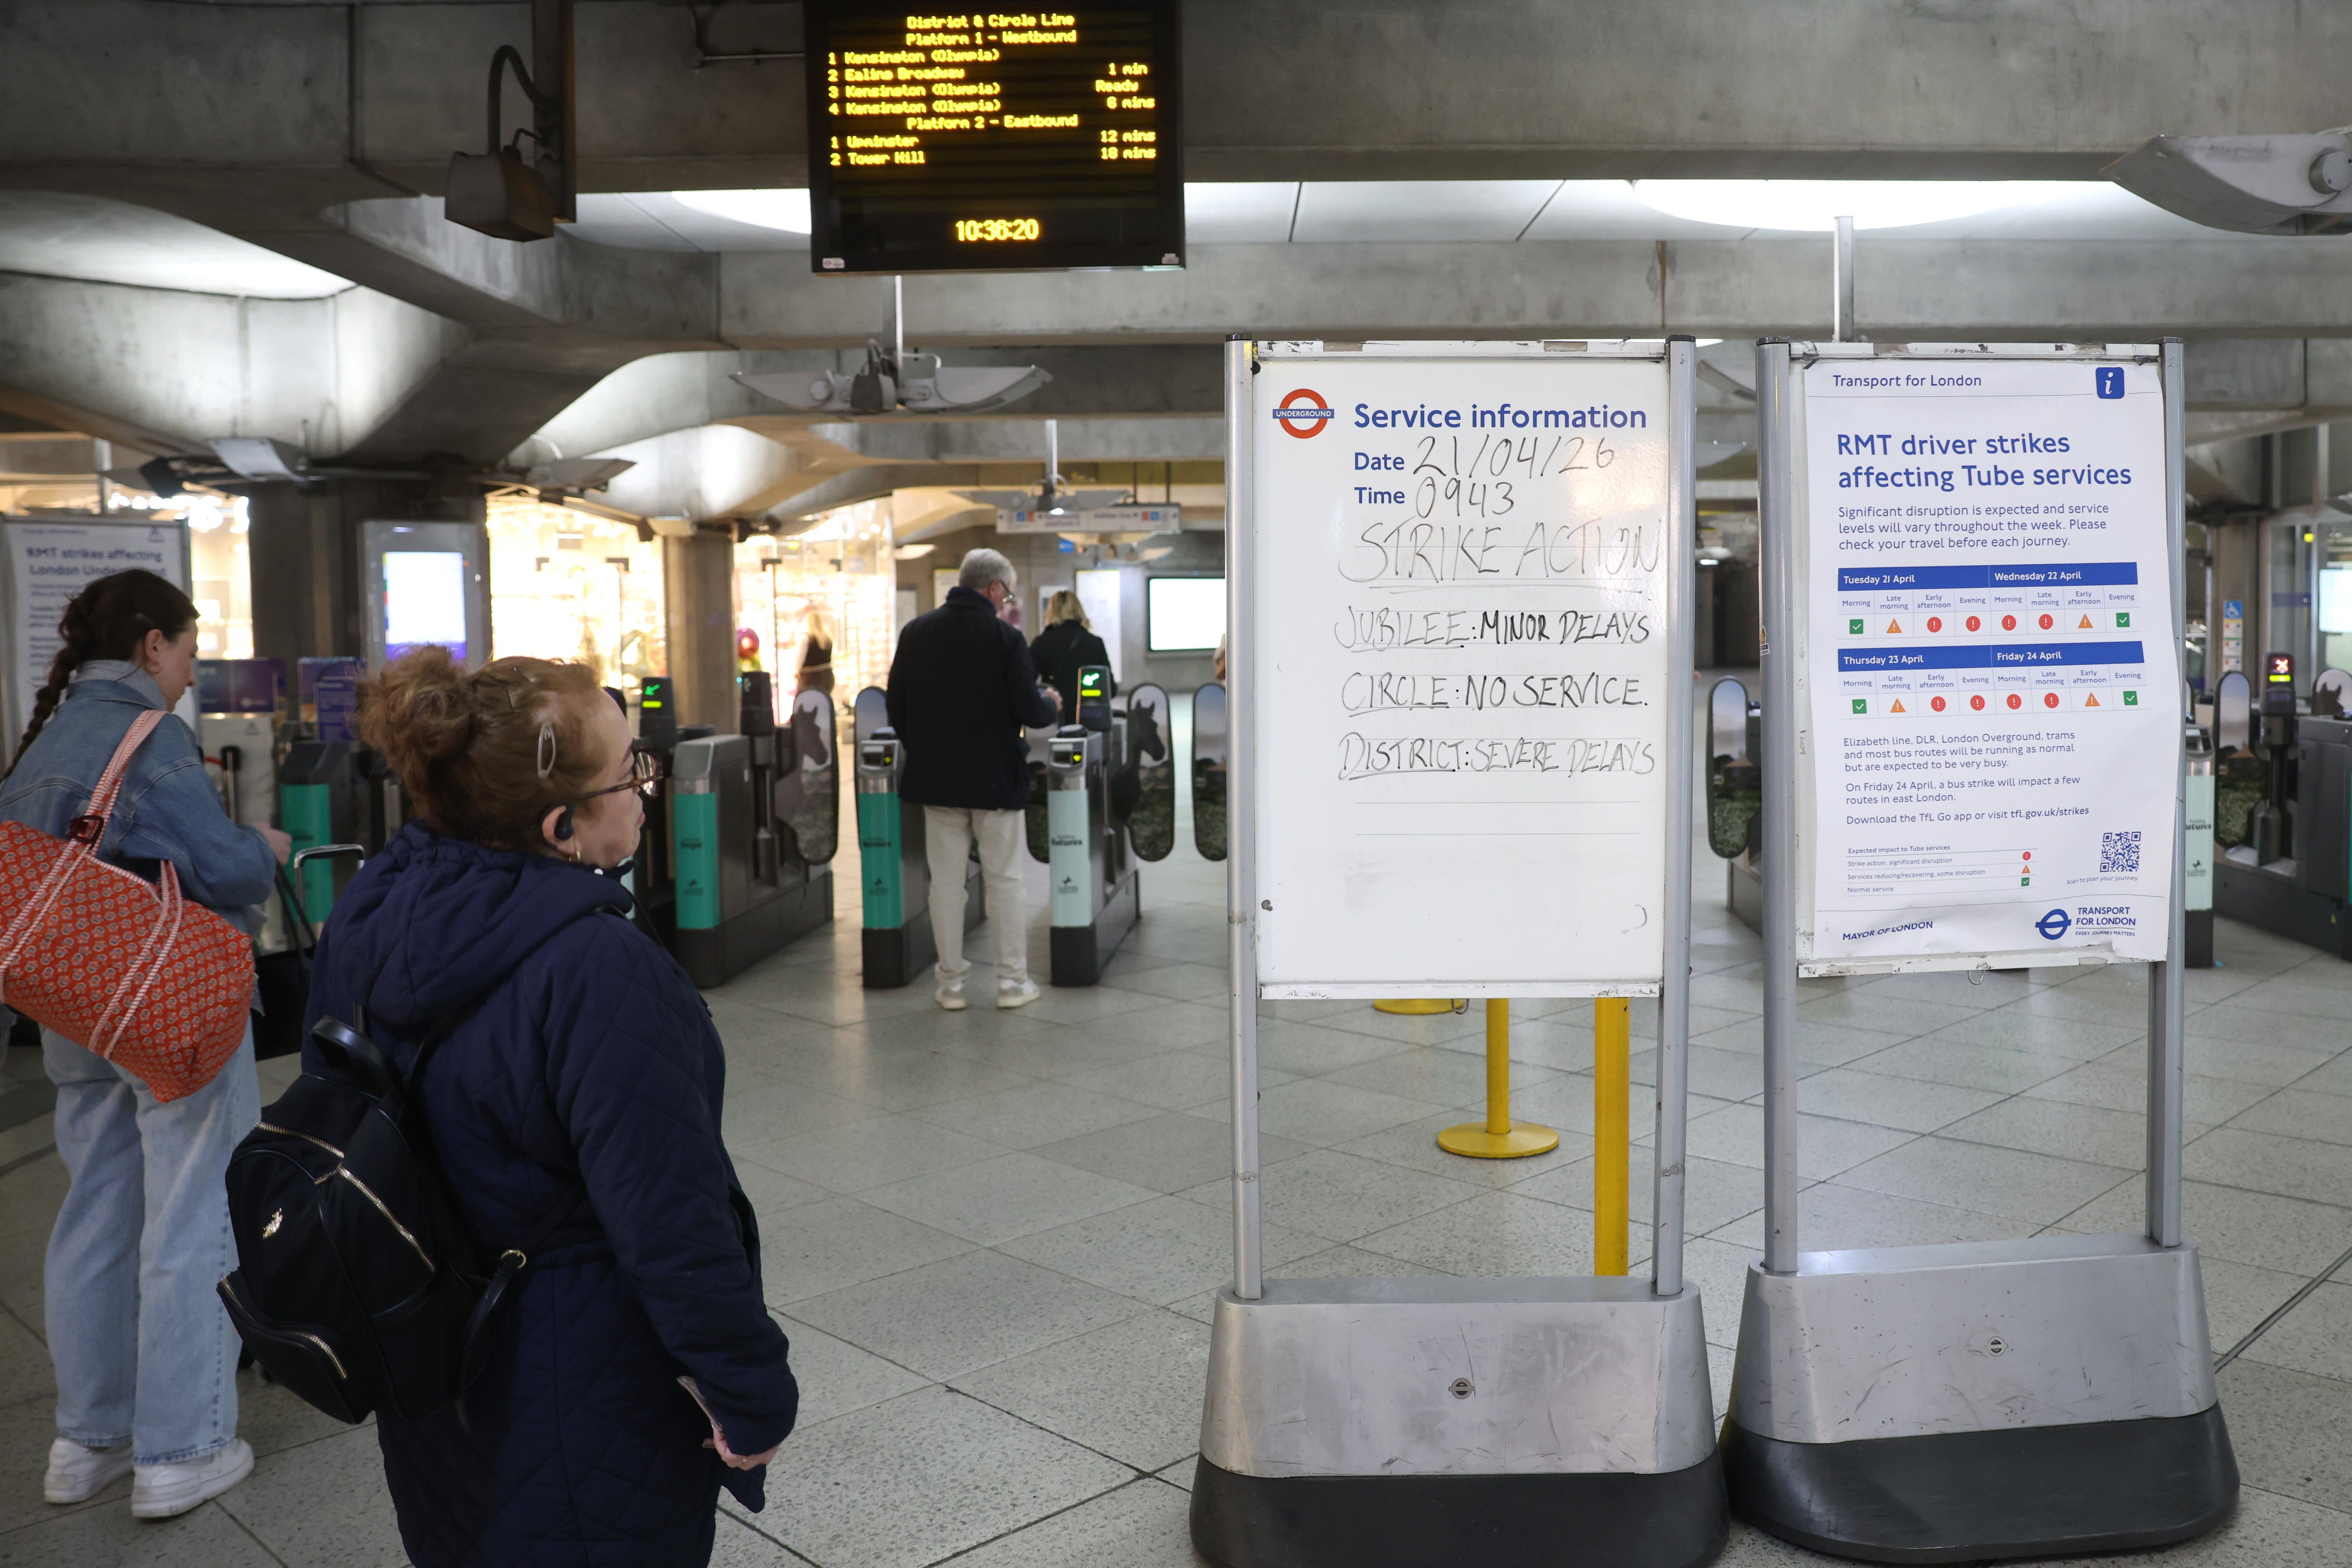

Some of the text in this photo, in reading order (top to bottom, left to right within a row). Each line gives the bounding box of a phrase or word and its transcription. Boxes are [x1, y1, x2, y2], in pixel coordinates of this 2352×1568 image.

[907, 13, 1075, 29] District & Circle Line
[906, 30, 1076, 46] Platform 1 Westbound
[829, 49, 999, 65] 1 Kensington (Olympia)
[828, 67, 965, 82] 2 Ealing Broadway
[1109, 63, 1147, 75] 1 min
[829, 82, 1000, 99] 3 Kensington (Olympia)
[1096, 79, 1138, 93] Ready
[829, 99, 1001, 115] 4 Kensington (Olympia)
[1107, 96, 1155, 109] 6 mins
[907, 114, 1078, 130] Platform 2 Eastbound
[831, 135, 919, 149] 1 Upminster
[1101, 130, 1156, 143] 12 mins
[831, 151, 925, 166] 2 Tower Hill
[1101, 147, 1156, 159] 18 mins
[956, 219, 1040, 241] 10:36:20
[1833, 375, 1981, 389] Transport for London
[1354, 404, 1645, 428] Service information
[1838, 433, 2070, 455] RMT driver strikes
[1355, 452, 1404, 470] Date
[1413, 434, 1615, 479] 21/04/26
[1839, 464, 2131, 492] affecting Tube services
[1354, 487, 1405, 503] Time
[1416, 477, 1514, 519] 0943
[1839, 504, 2108, 520] Significant disruption is expected and service
[1840, 520, 2106, 534] levels will vary throughout the week. Please
[1338, 516, 1661, 583] STRIKE ACTION
[1840, 537, 2070, 551] check your travel before each journey.
[26, 547, 163, 562] RMT strikes affecting
[1844, 576, 1880, 585] Tuesday
[1893, 575, 1915, 584] April
[1995, 572, 2045, 581] Wednesday
[2060, 572, 2081, 581] April
[1844, 656, 1886, 665] Thursday
[1901, 655, 1923, 665] April
[1998, 653, 2024, 661] Friday
[2040, 651, 2062, 661] April
[1844, 737, 1889, 746] Elizabeth
[1942, 735, 1978, 743] London
[1982, 732, 2043, 743] Overground,
[1845, 750, 1862, 759] and
[1986, 746, 2023, 755] running
[2040, 744, 2074, 752] normal
[1884, 761, 1928, 772] expected
[1984, 759, 2008, 768] busy.
[1847, 815, 1896, 824] Download
[2011, 807, 2089, 819] tfl.gov.uk/strikes
[1843, 930, 1874, 941] MAYOR
[1891, 921, 1933, 933] LONDON
